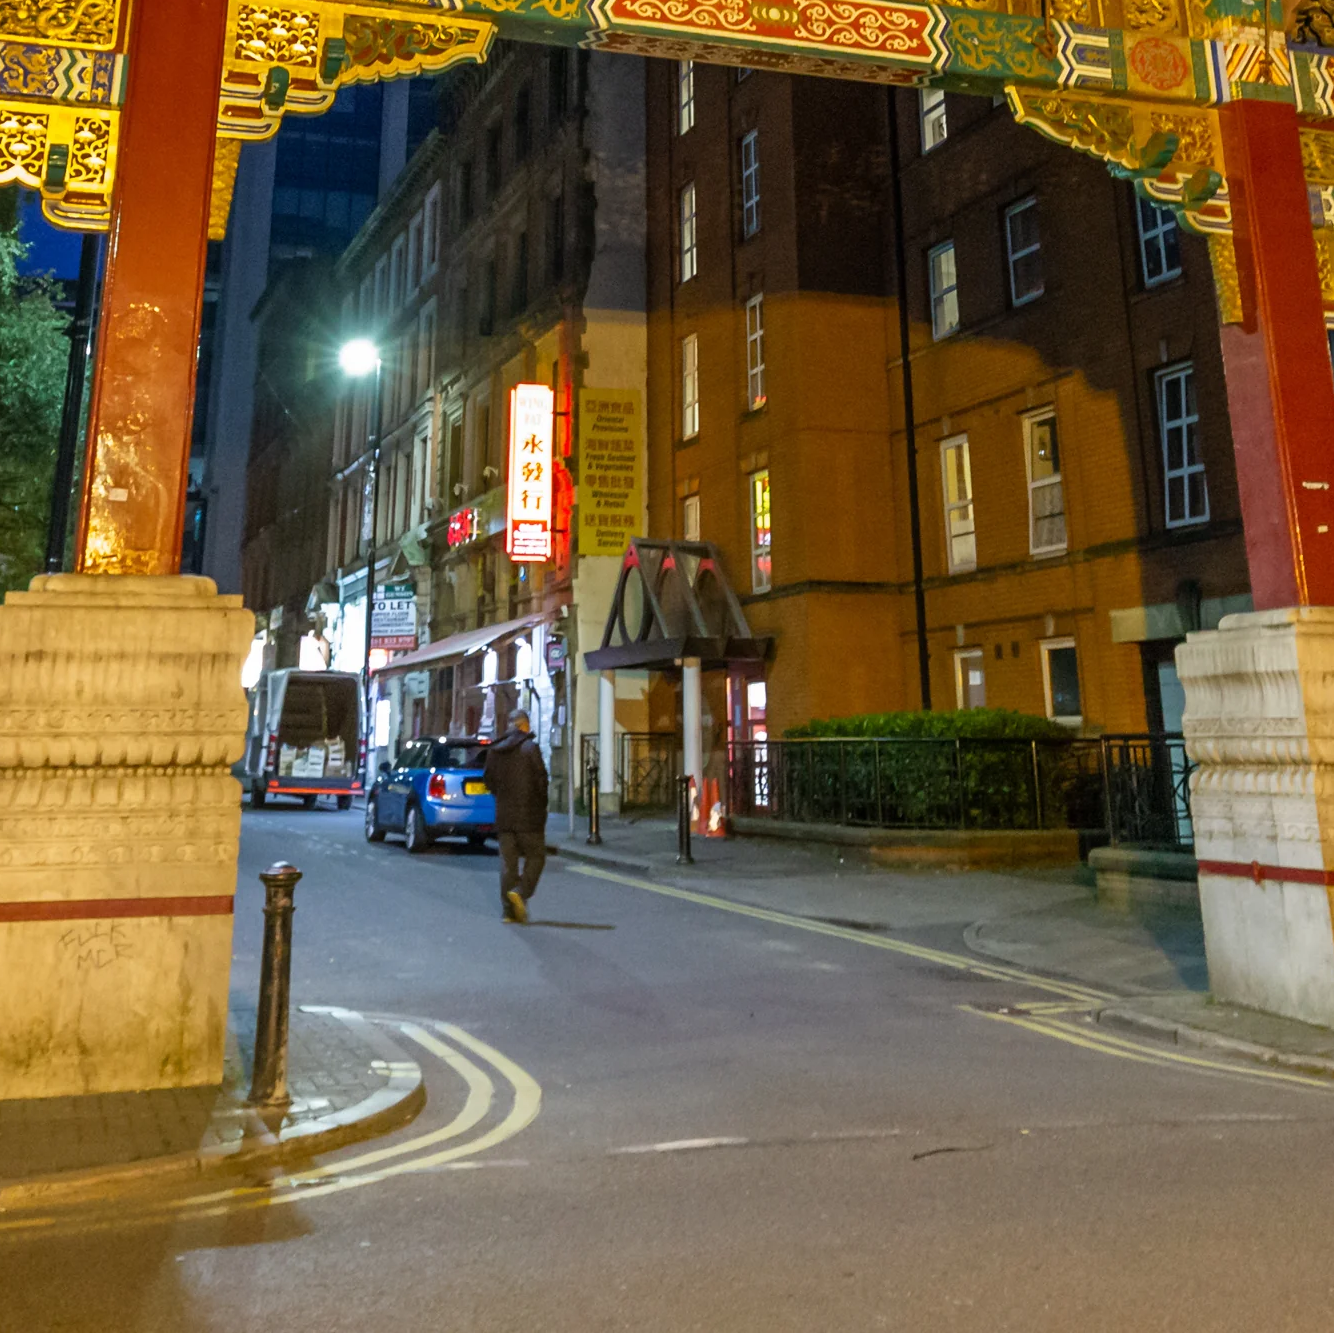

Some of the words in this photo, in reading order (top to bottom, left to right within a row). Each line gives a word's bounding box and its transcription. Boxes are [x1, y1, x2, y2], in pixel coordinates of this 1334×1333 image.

[595, 529, 625, 539] Delivery
[597, 538, 624, 548] Service
[373, 601, 386, 611] TO
[390, 600, 412, 610] LET
